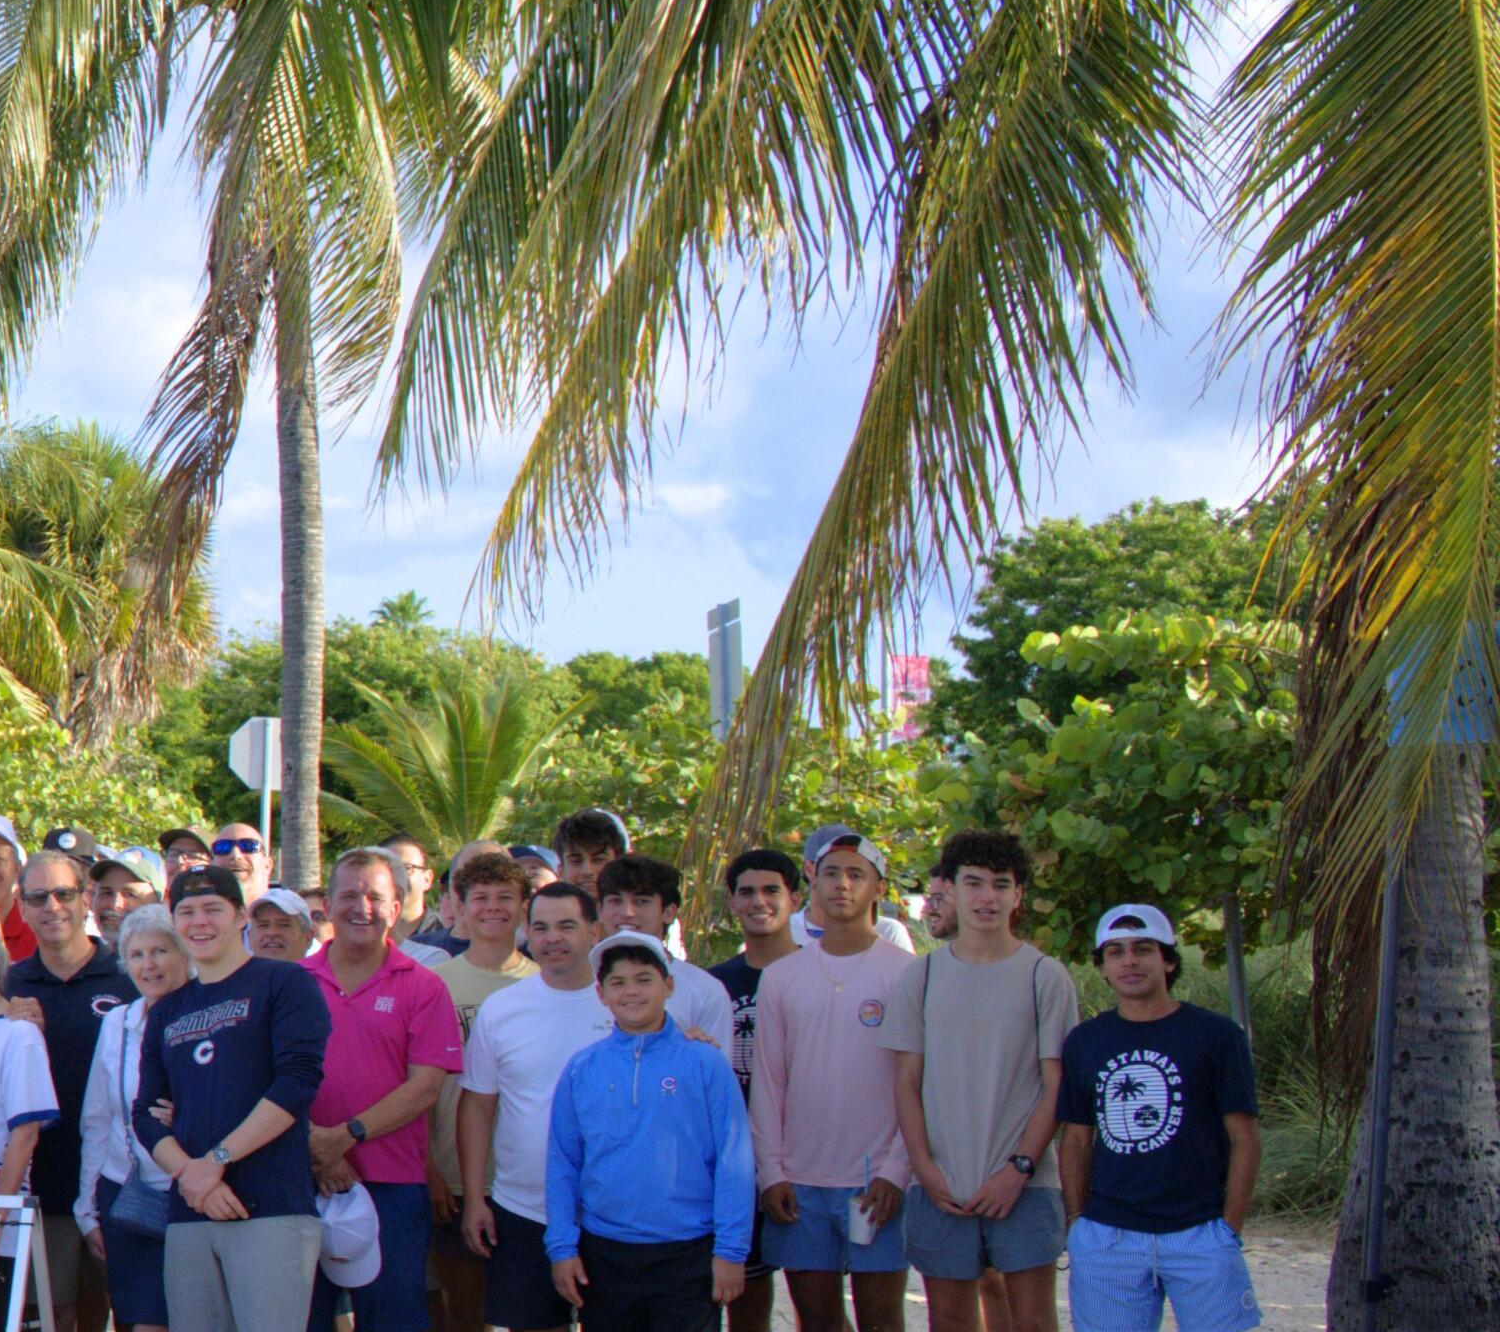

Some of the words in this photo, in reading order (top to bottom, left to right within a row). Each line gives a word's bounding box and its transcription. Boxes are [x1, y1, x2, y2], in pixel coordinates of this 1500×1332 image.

[193, 1040, 215, 1065] C
[1095, 1050, 1182, 1093] CASTAWAYS
[1137, 1106, 1184, 1153] CANCER
